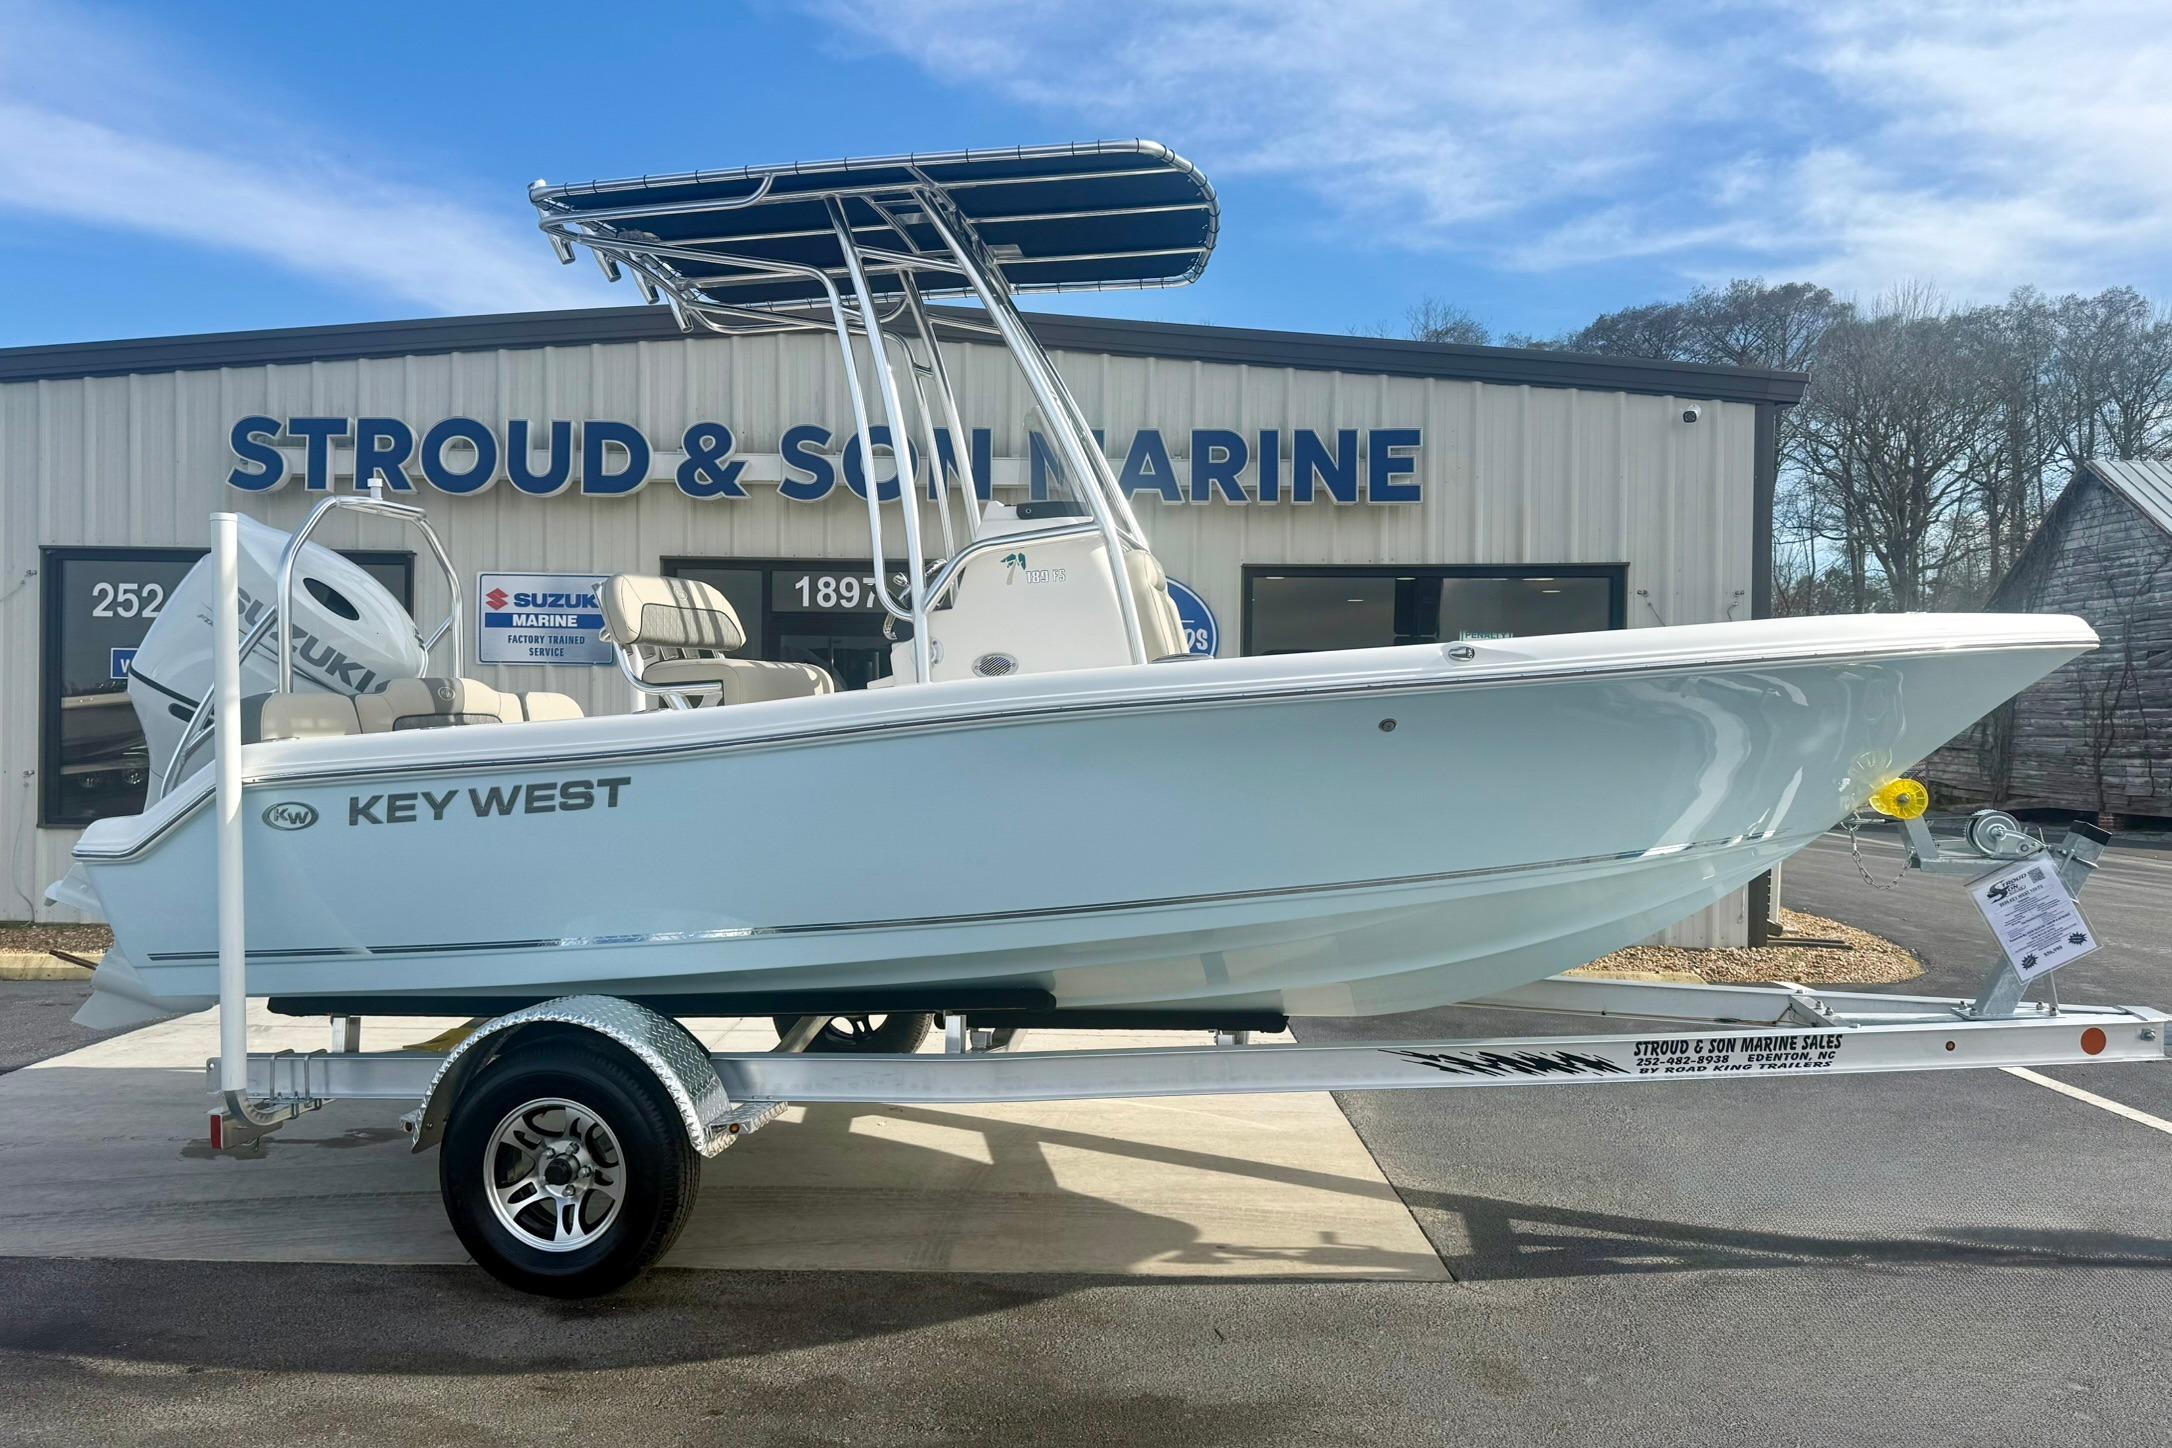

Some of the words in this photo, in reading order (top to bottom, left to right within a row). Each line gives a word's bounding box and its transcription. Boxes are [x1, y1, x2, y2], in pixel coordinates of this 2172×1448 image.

[225, 413, 655, 498] STROUD
[674, 420, 752, 500] &
[776, 422, 992, 502] SON
[1028, 427, 1424, 506] MARINE
[92, 582, 164, 618] 252
[513, 592, 600, 608] SUZUK
[794, 575, 876, 608] 1897
[512, 614, 578, 627] MARINE
[507, 634, 545, 644] FACTORY
[548, 635, 585, 645] TRAINED
[529, 647, 564, 656] SERVICE
[348, 789, 459, 827] KEY
[468, 776, 632, 818] WEST
[1633, 1039, 1690, 1057] STROUD
[1693, 1039, 1704, 1054] &
[1707, 1037, 1737, 1054] SON
[1740, 1035, 1798, 1053] MARINE
[1801, 1034, 1843, 1051] SALES
[1636, 1054, 1730, 1067] 252-482-8938
[1747, 1052, 1813, 1063] EDENTON,
[1817, 1050, 1836, 1060] NC
[1638, 1067, 1660, 1075] BY
[1664, 1065, 1708, 1074] ROAD
[1712, 1063, 1752, 1072] KING
[1758, 1060, 1833, 1071] TRAILERS
